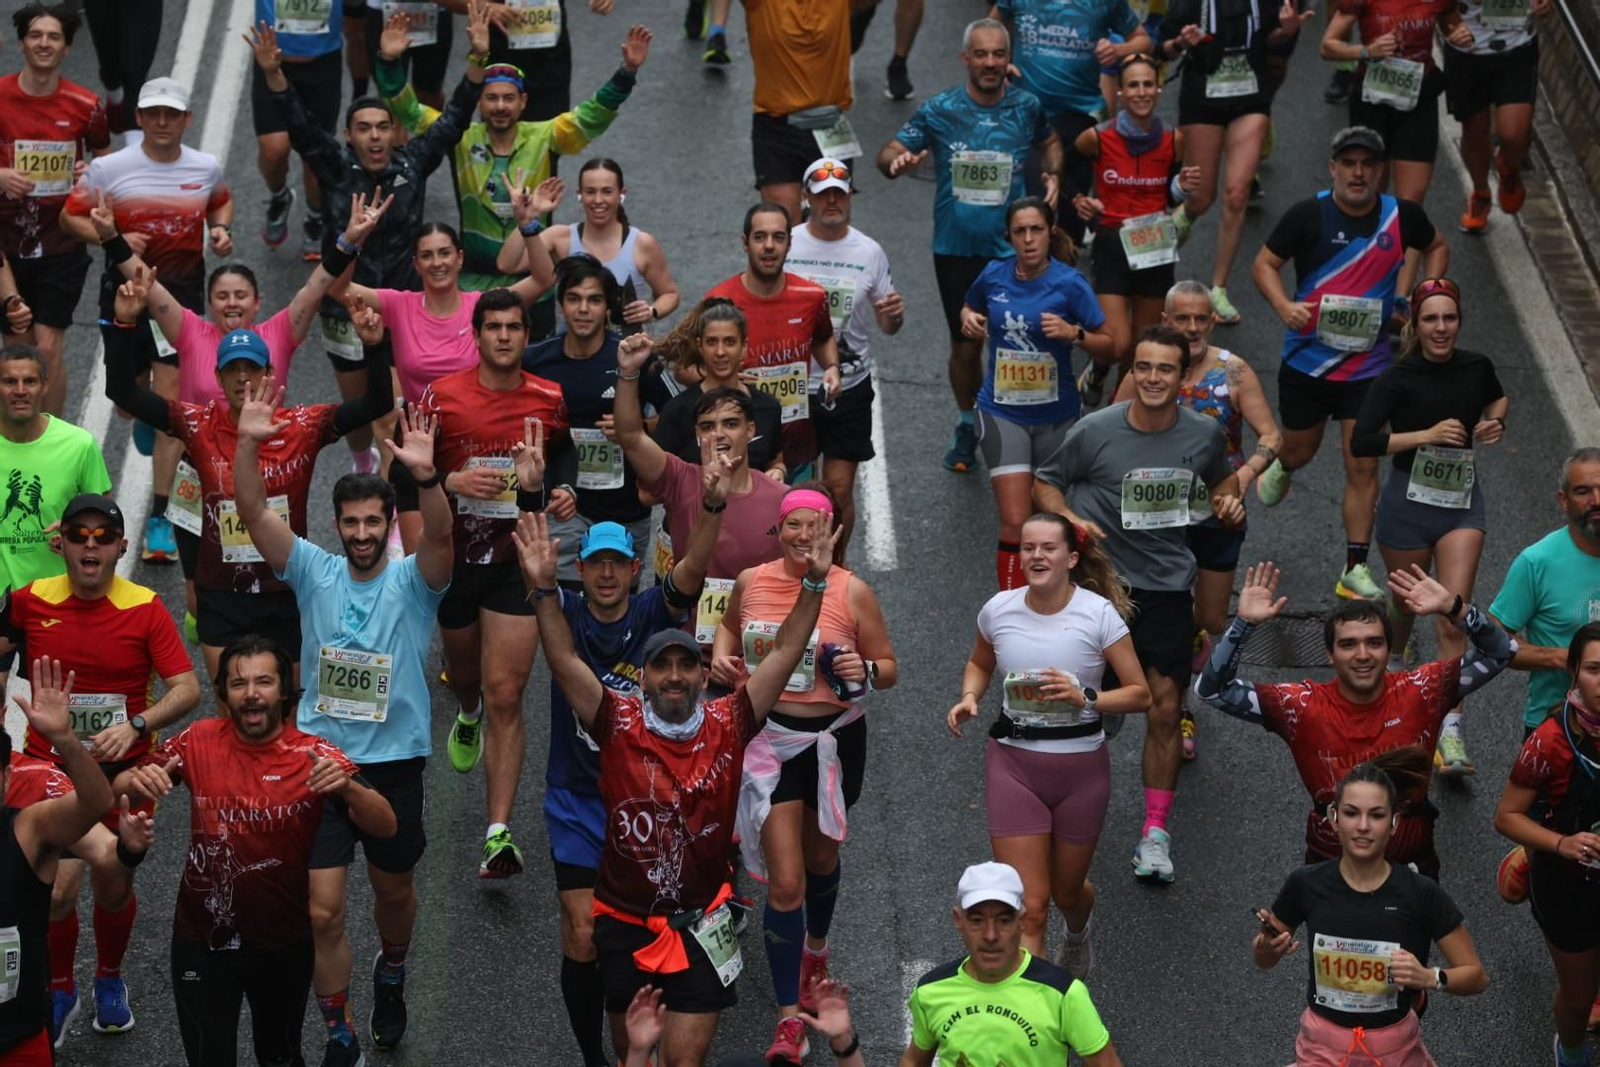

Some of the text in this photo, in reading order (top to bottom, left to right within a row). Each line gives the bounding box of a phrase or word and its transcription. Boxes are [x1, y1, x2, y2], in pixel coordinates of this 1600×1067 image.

[1039, 24, 1078, 38] MEDIA
[1371, 67, 1414, 89] 10365
[21, 154, 68, 171] 12107
[961, 164, 998, 182] 7863
[1103, 169, 1168, 186] enduranc
[1328, 309, 1368, 328] 9807
[760, 341, 812, 365] MARAT
[1001, 363, 1046, 381] 11131
[1423, 461, 1463, 482] 6671
[1134, 483, 1175, 502] 9080
[326, 664, 371, 690] 7266
[1384, 718, 1402, 728] HOKA
[206, 796, 270, 810] MEDIO
[220, 800, 312, 823] MARATÓN
[619, 811, 653, 843] 30
[1322, 955, 1386, 982] 11058
[965, 1005, 980, 1016] EL
[986, 1005, 1038, 1047] RONQUILLO
